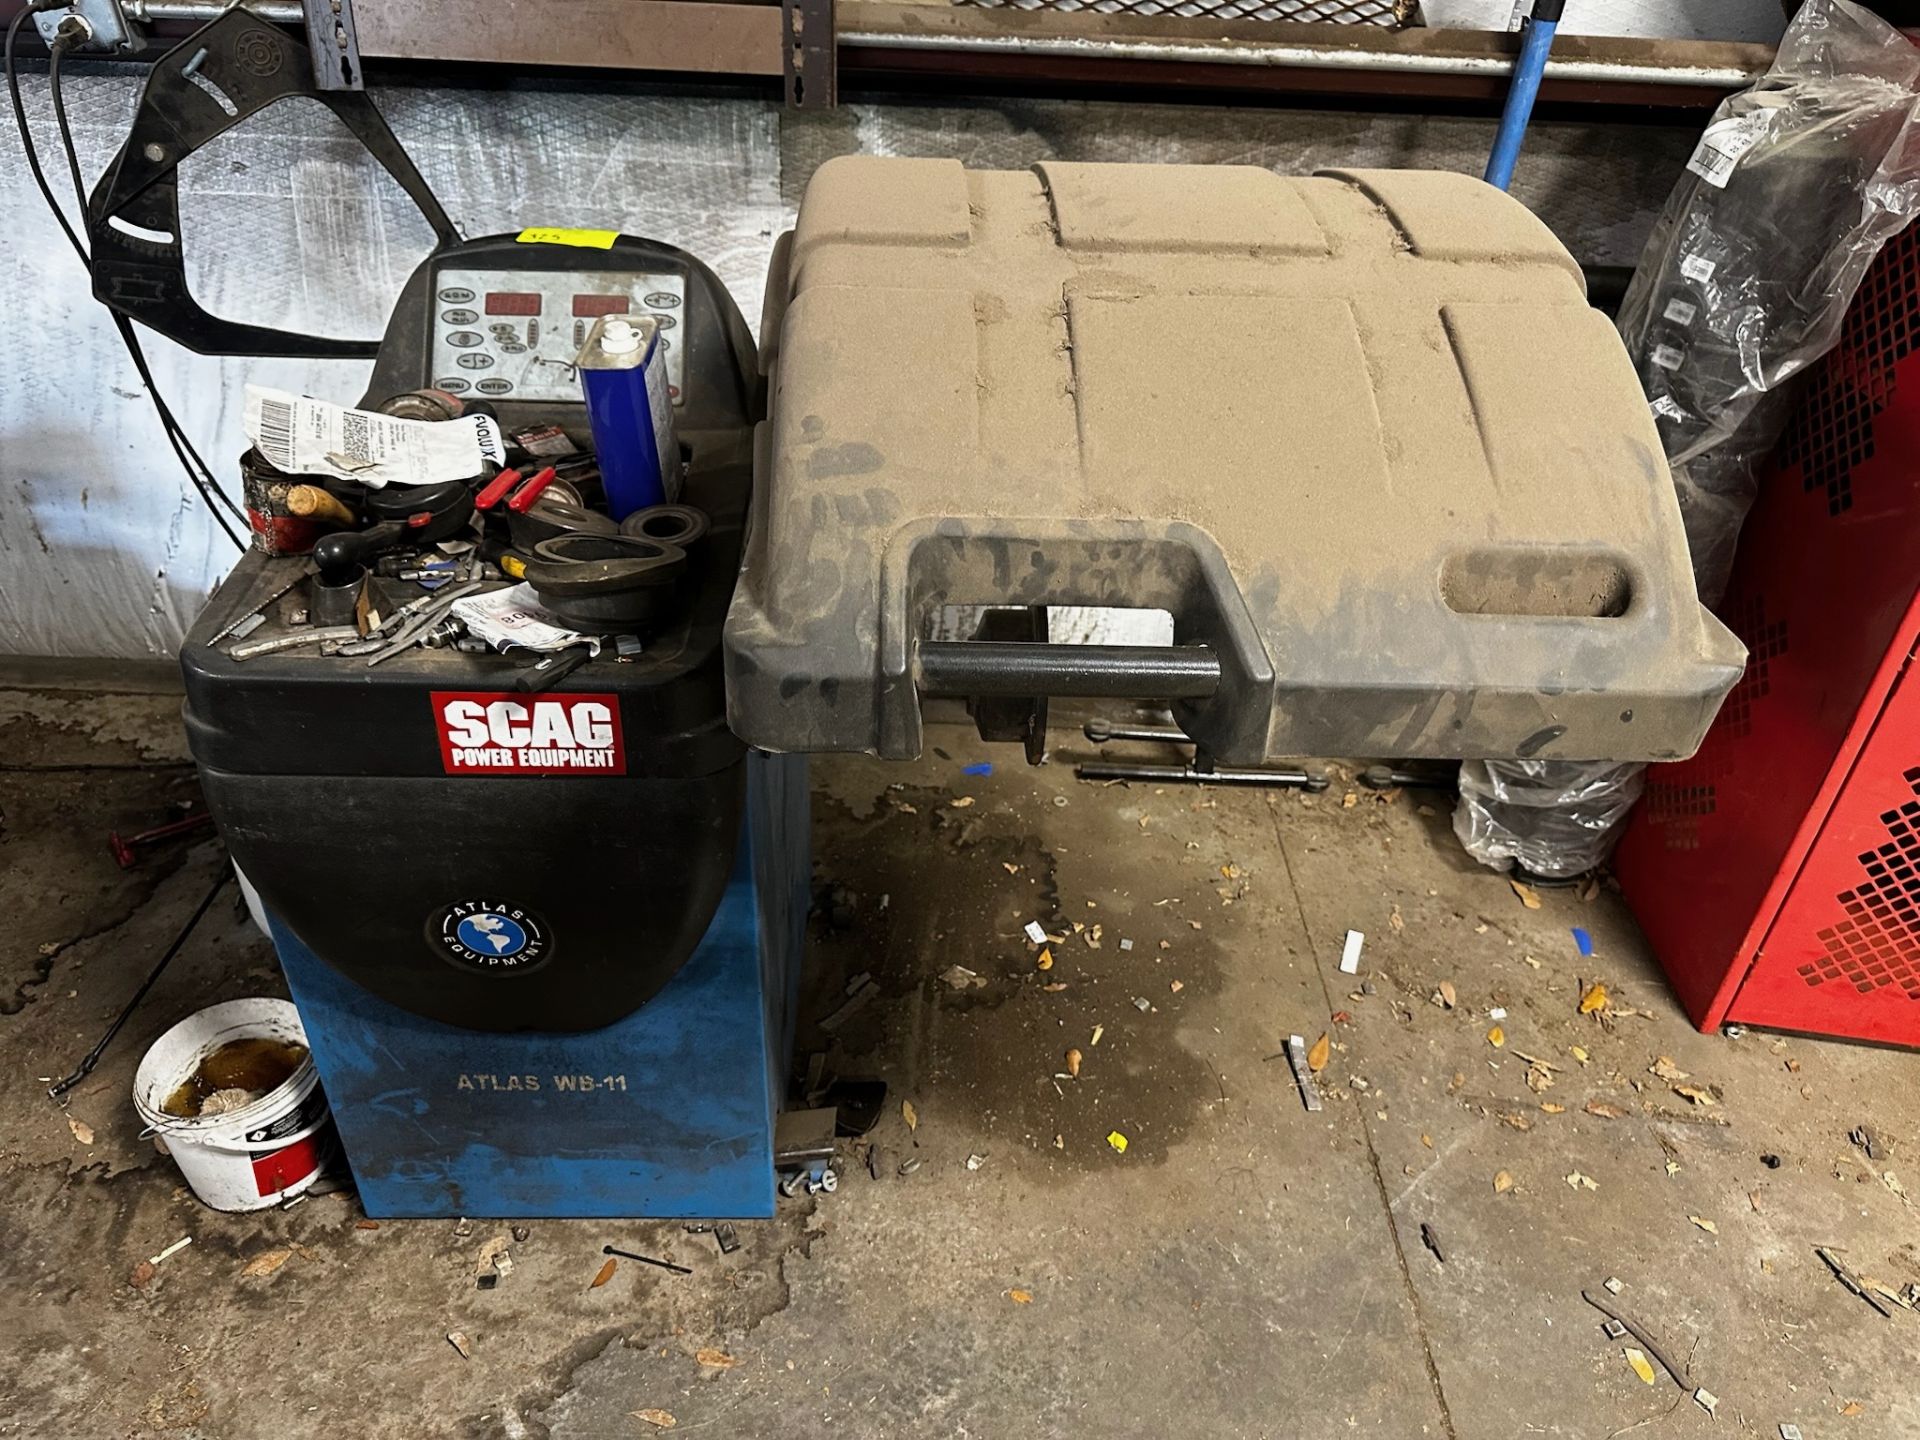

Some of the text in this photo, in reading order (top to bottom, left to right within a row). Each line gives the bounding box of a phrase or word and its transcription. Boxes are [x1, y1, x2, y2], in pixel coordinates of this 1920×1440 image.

[480, 382, 508, 390] ENTER
[444, 700, 614, 748] SCAG
[451, 748, 615, 768] POWER EQUIPMENT
[453, 902, 524, 920] ATLAS
[443, 936, 543, 966] EQUIPMENT
[457, 1073, 628, 1092] ATLAS WB-11
